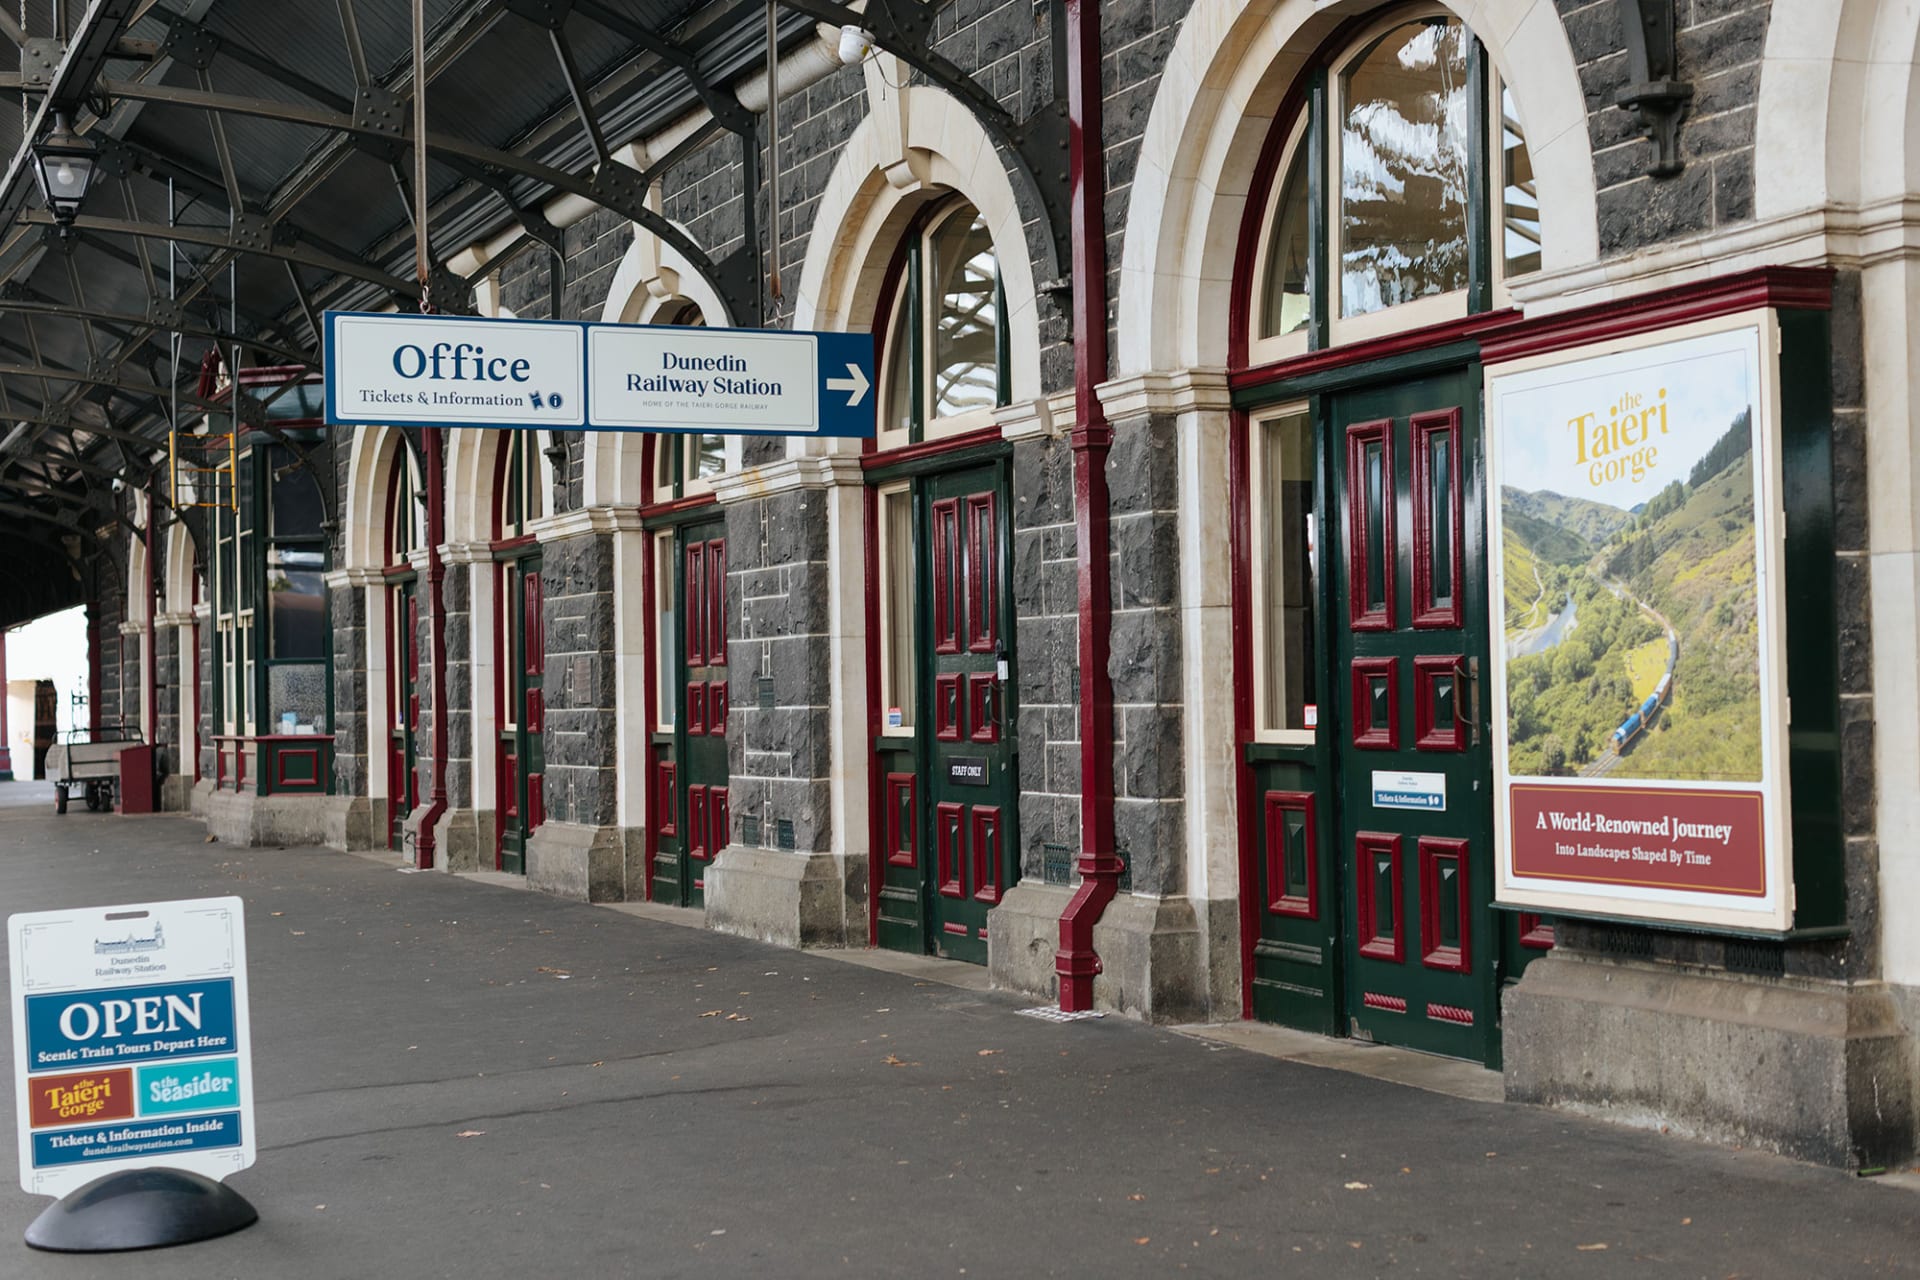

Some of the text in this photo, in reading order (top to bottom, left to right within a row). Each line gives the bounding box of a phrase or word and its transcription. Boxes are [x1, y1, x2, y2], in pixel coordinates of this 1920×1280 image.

[392, 342, 530, 382] Office
[662, 352, 747, 372] Dunedin
[360, 389, 524, 406] Tickets & Information
[627, 374, 782, 397] Railway Station
[1620, 392, 1642, 412] the
[1567, 388, 1669, 465] Taieri
[1589, 446, 1657, 486] Gorge
[952, 765, 982, 776] STAFF ONLY
[1536, 811, 1732, 845] A World-Renowned Journey
[1556, 842, 1712, 866] Into Landscapes Shaped By Time
[59, 992, 204, 1041] OPEN
[38, 1036, 226, 1062] Scenic Train Tours Depart Here
[45, 1078, 112, 1110] Taieri
[78, 1079, 95, 1088] the
[150, 1072, 232, 1102] Seasider
[162, 1076, 179, 1088] the
[60, 1099, 104, 1118] Gorge
[50, 1120, 223, 1148] Tickets & Information Inside
